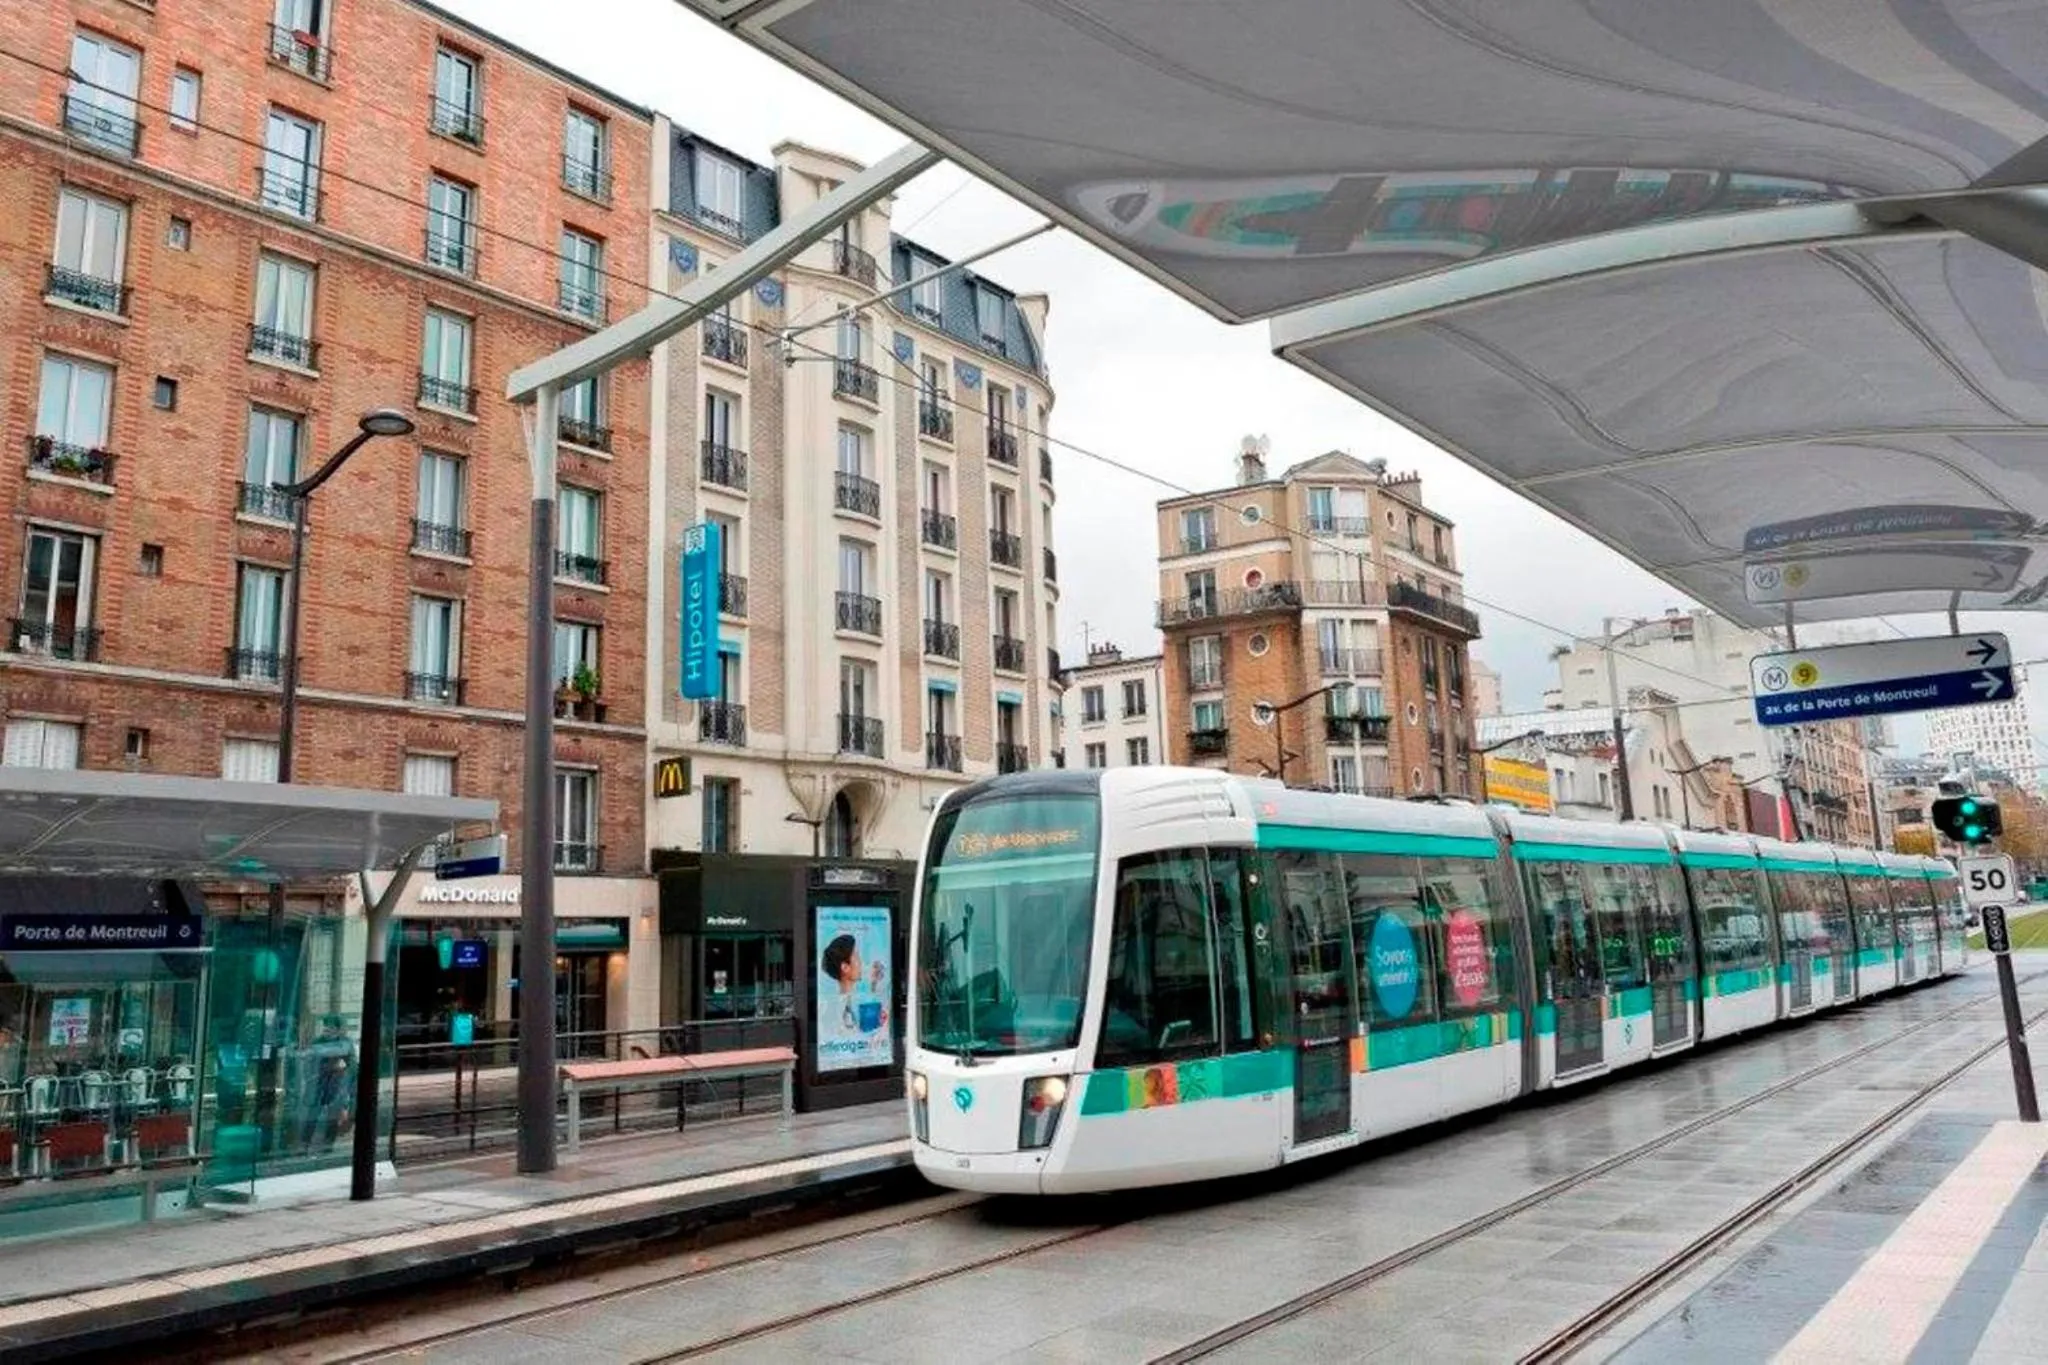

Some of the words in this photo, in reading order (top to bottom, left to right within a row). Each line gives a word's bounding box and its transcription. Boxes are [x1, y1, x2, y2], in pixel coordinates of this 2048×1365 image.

[687, 572, 706, 680] Hipotel
[1784, 702, 1799, 713] de
[1802, 700, 1814, 711] la
[1817, 697, 1850, 711] Porte
[1854, 693, 1870, 705] de
[1873, 685, 1939, 703] Montreuil
[1970, 868, 2006, 891] 50
[421, 886, 519, 902] McDonald
[14, 924, 60, 940] Porte
[65, 924, 86, 939] de
[90, 924, 168, 940] Montreuil
